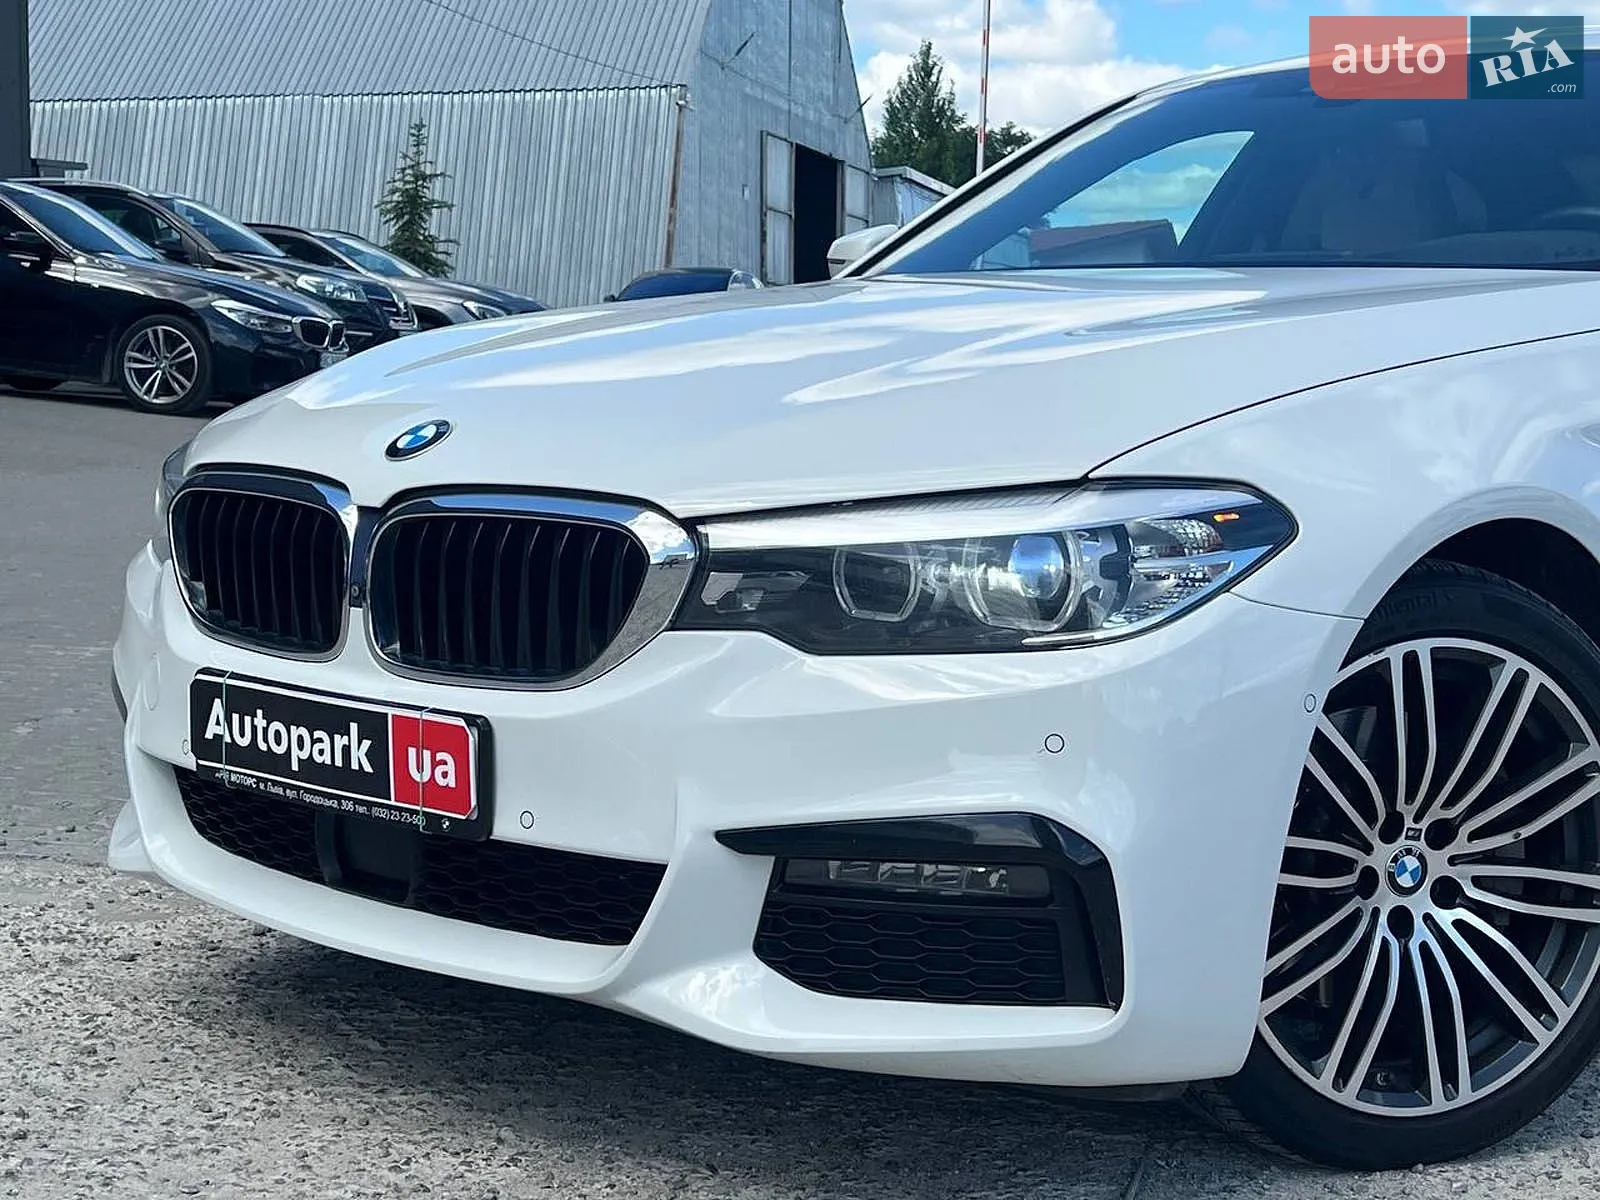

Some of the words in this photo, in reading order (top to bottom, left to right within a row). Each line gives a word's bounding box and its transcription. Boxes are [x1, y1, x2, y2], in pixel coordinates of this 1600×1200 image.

[204, 698, 374, 773] Autopark
[407, 746, 456, 788] ua
[230, 772, 257, 788] МОТОРС
